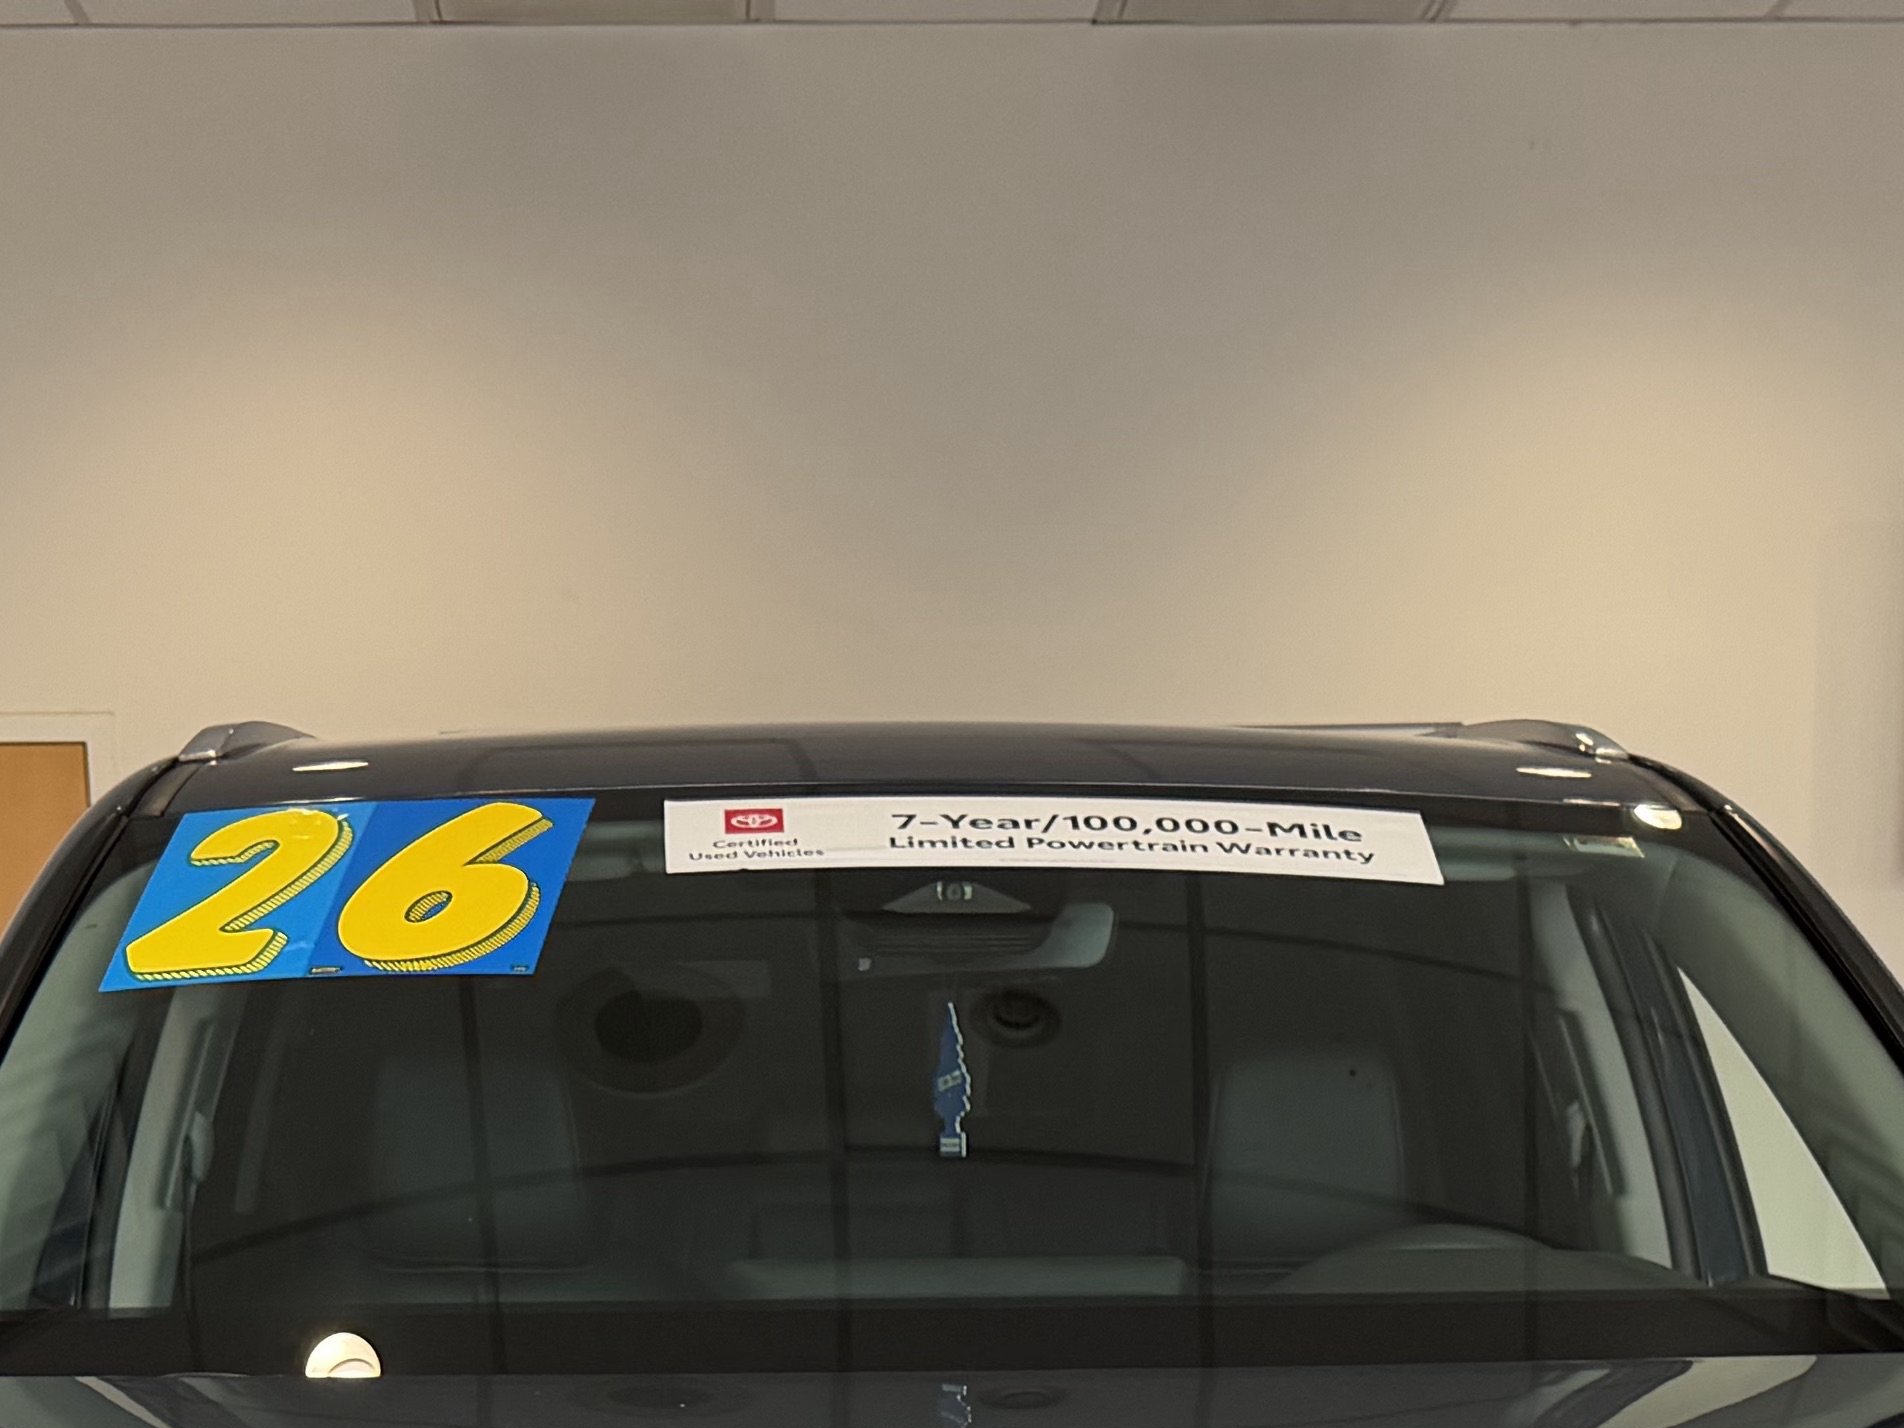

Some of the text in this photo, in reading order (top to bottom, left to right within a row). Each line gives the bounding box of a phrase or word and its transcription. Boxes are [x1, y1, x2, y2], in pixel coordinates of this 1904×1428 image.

[712, 838, 798, 849] Certified
[890, 814, 1363, 844] 7-Year/100,000-Mile
[689, 848, 825, 861] Used Vehicles
[888, 836, 1377, 866] Limited Powertrain Warranty
[126, 802, 553, 983] 26
